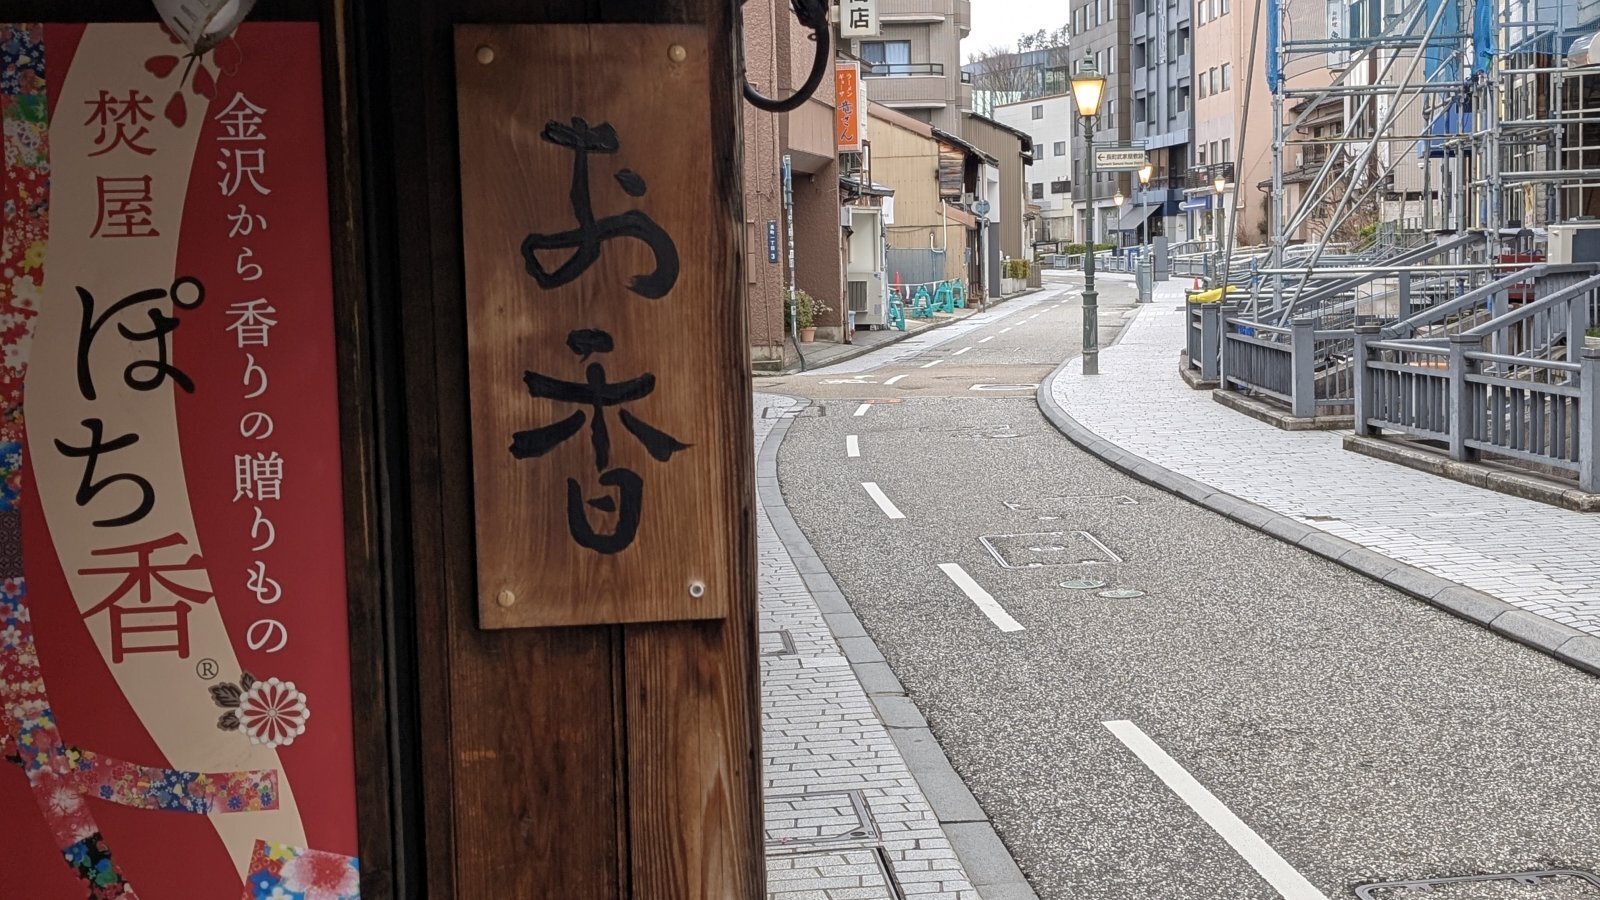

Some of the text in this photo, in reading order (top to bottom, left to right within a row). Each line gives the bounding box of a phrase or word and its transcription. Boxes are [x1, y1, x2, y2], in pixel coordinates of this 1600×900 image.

[850, 0, 869, 29] 店
[54, 89, 214, 664] 焚屋 ぽち香
[214, 91, 288, 654] 金沢から香りの贈りもの
[509, 117, 696, 555] お香
